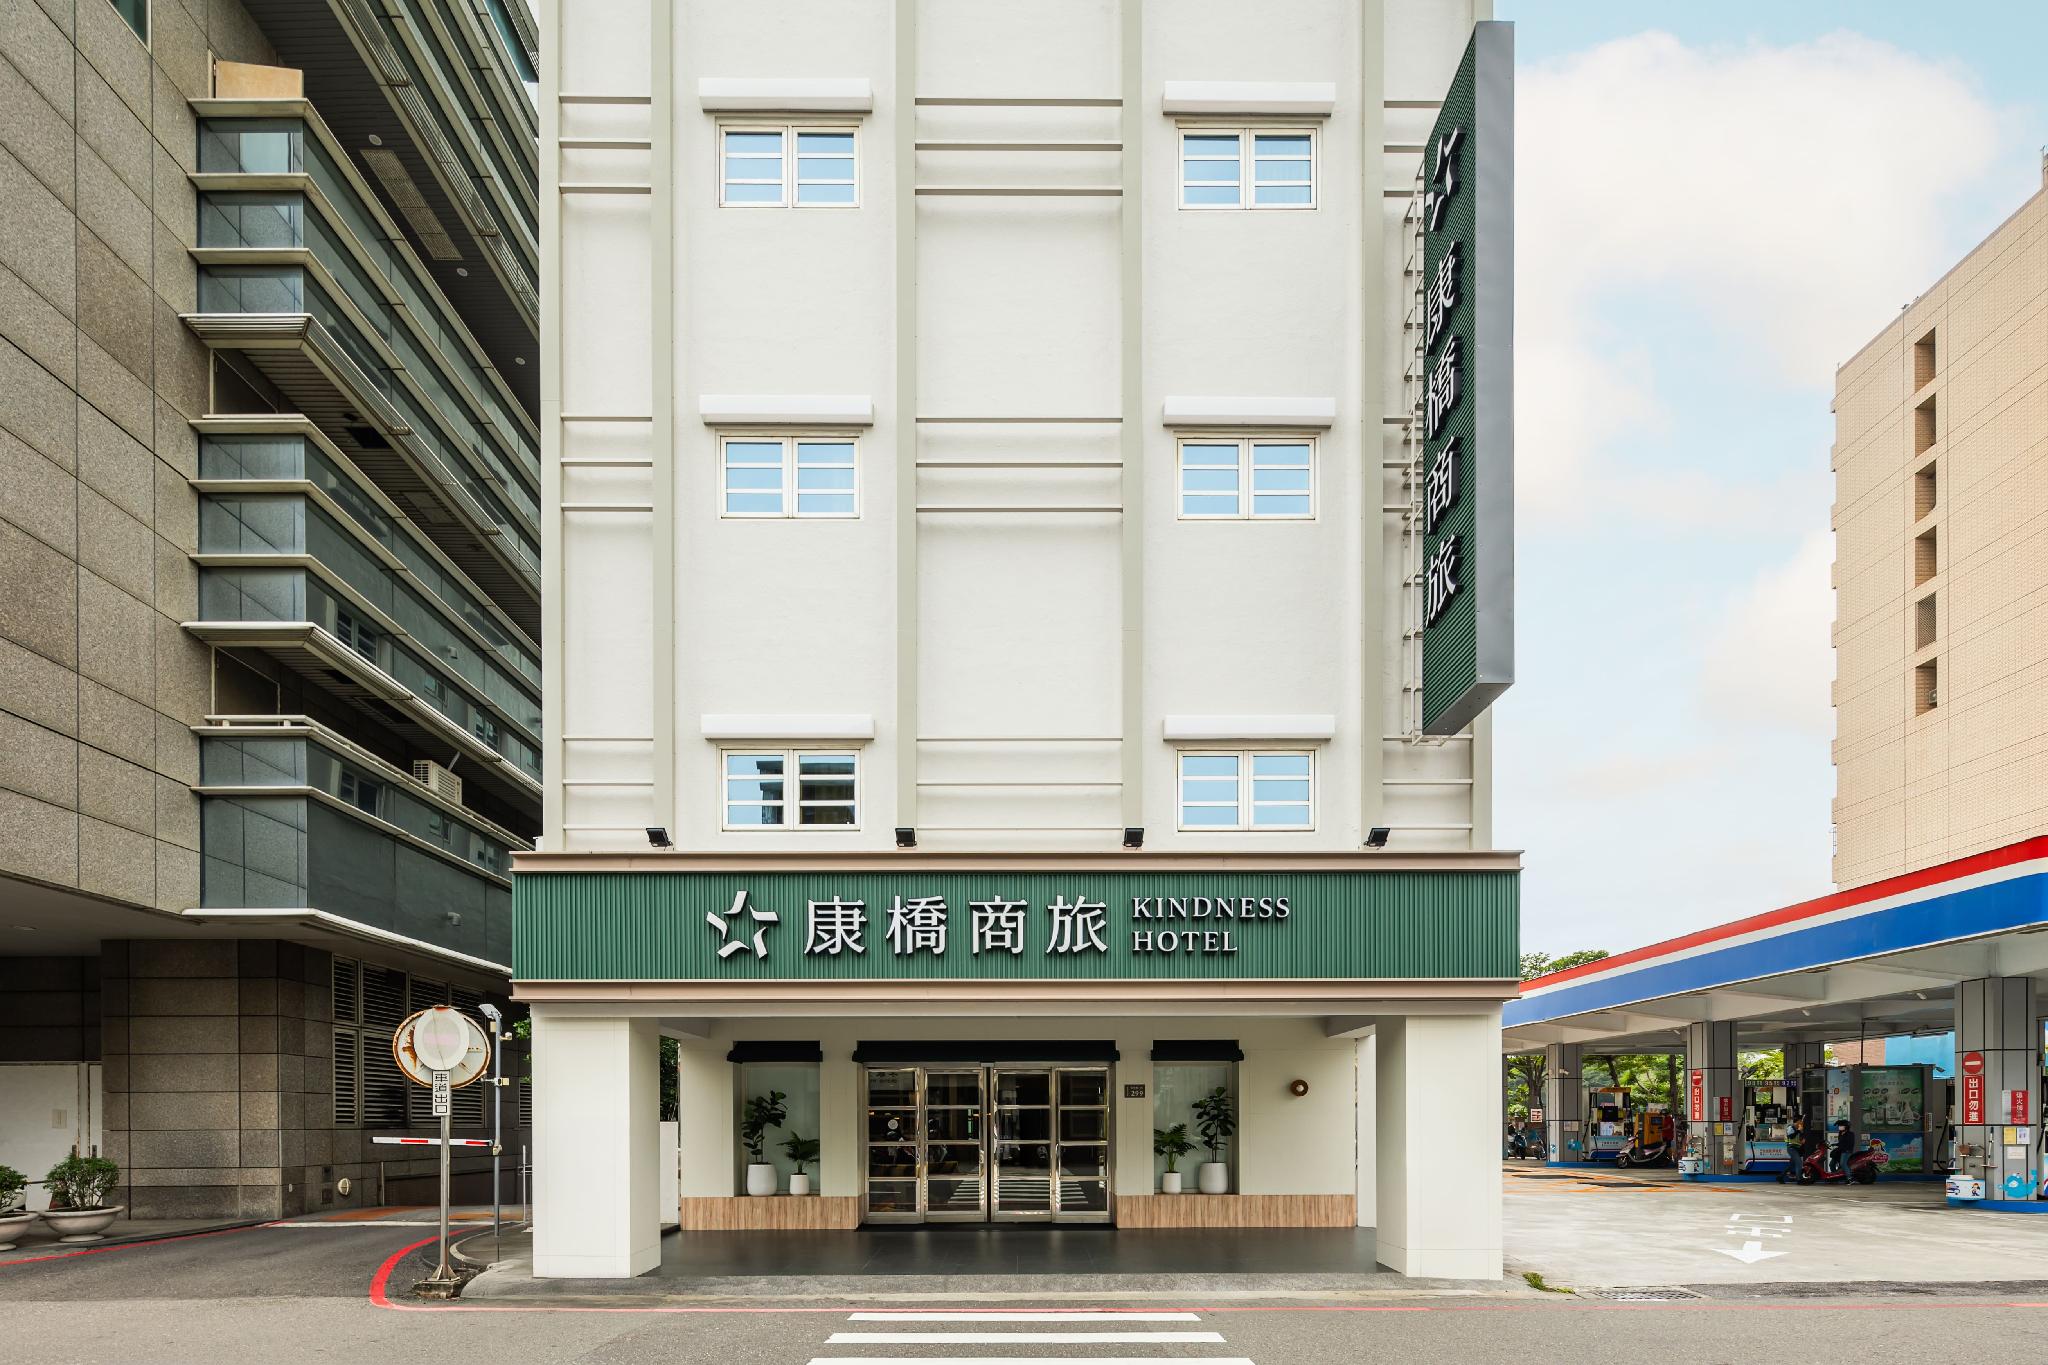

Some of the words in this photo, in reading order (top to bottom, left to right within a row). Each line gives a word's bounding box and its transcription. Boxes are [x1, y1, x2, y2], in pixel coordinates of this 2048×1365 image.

[1425, 240, 1461, 629] 康橋商旅
[803, 894, 1109, 955] 康橋商旅
[1131, 896, 1291, 919] KINDNESS
[1131, 929, 1239, 952] HOTEL
[434, 1073, 448, 1114] 車道出口
